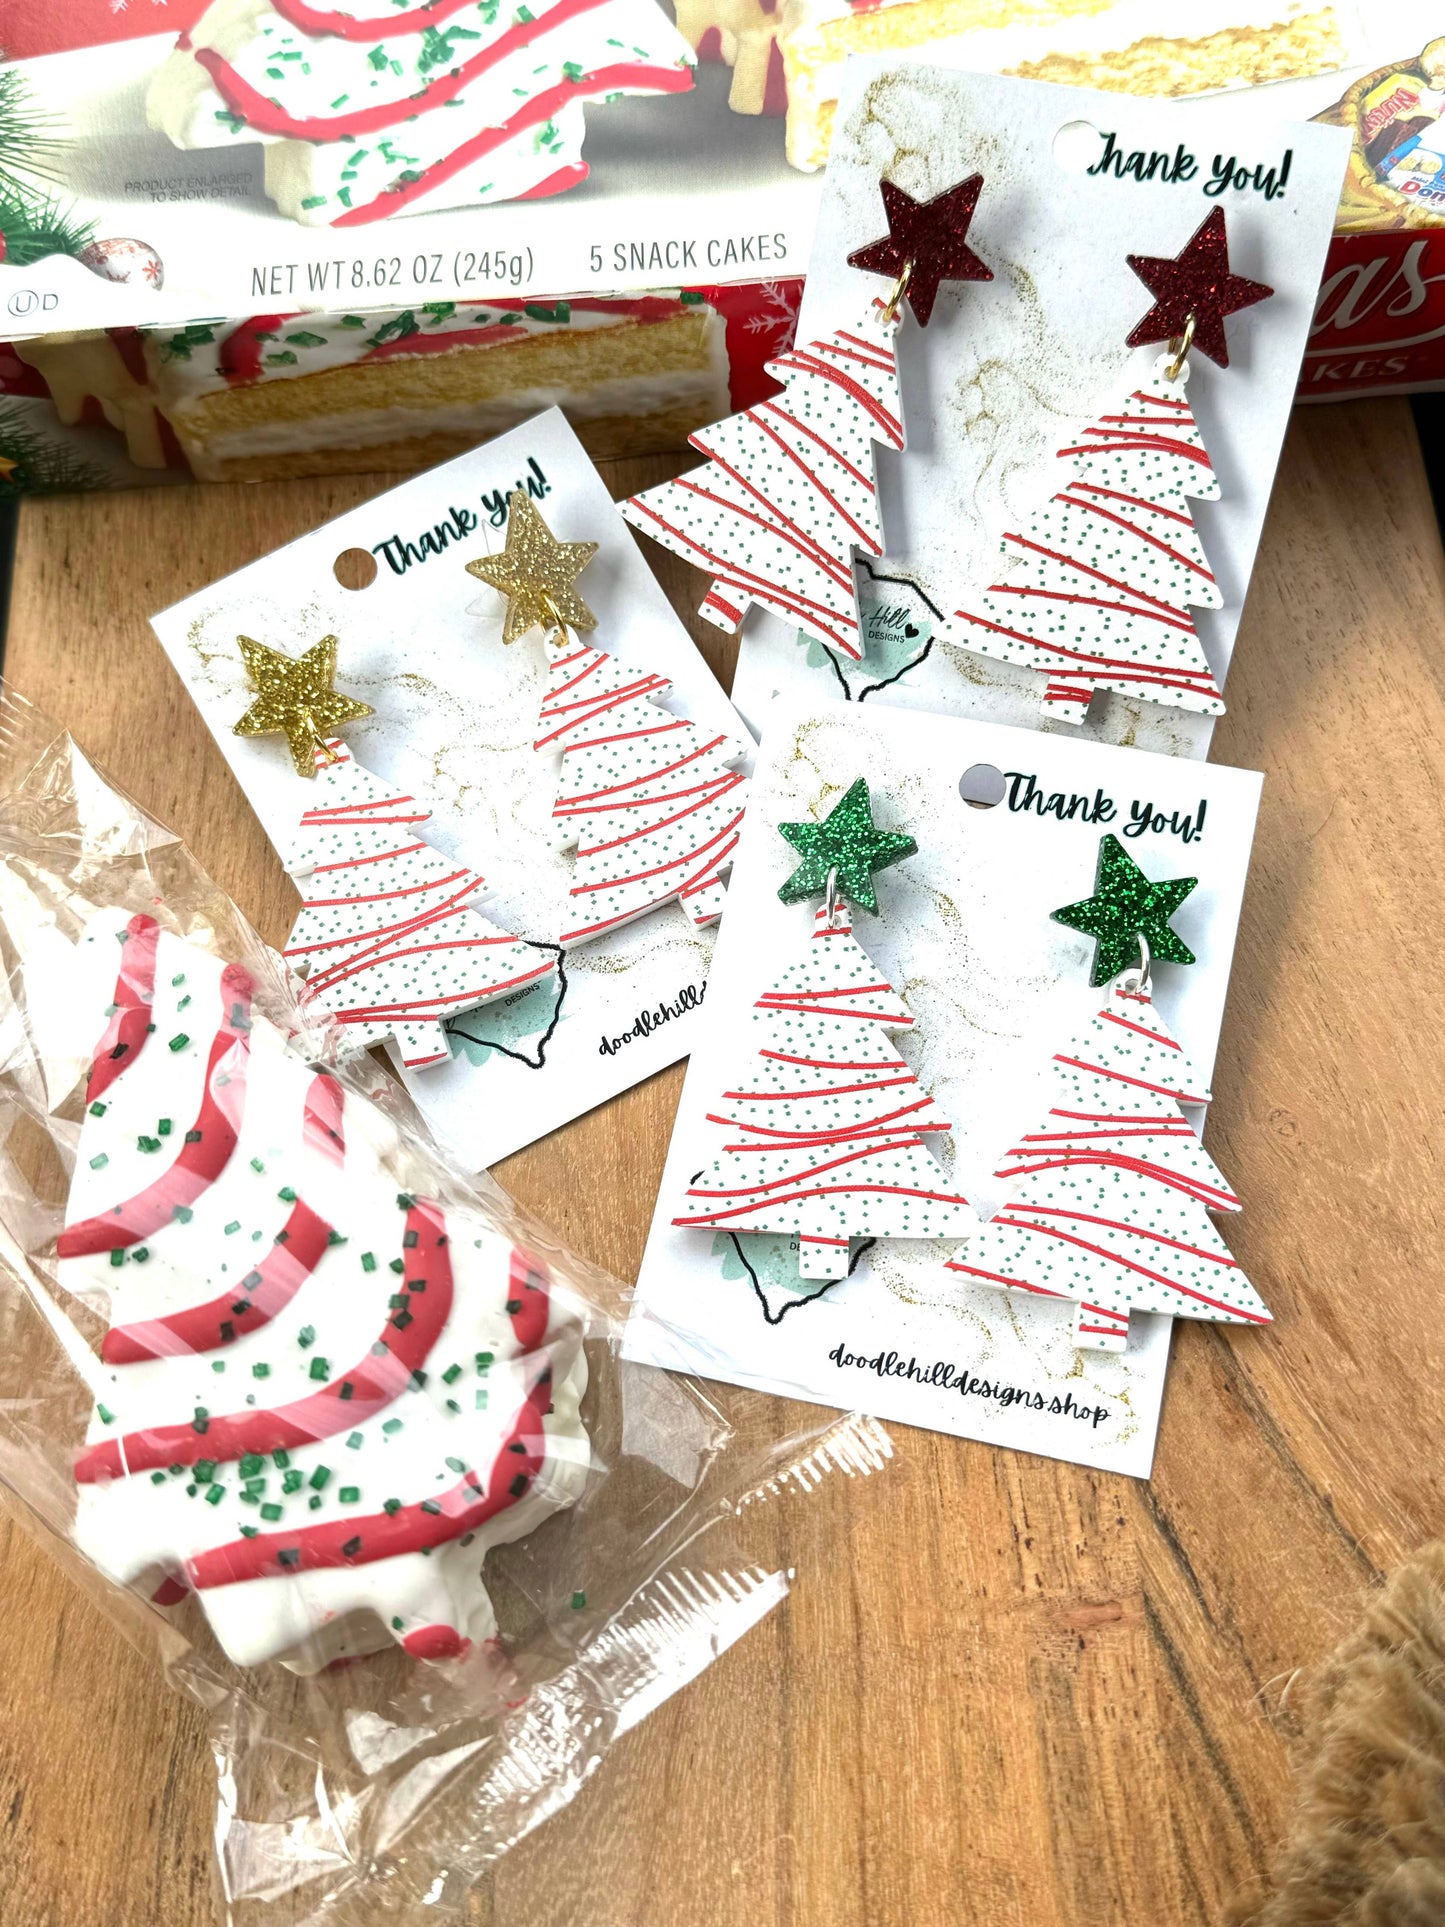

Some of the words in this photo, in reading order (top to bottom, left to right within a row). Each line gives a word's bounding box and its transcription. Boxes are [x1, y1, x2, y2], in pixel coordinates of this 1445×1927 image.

[124, 178, 184, 193] PRODUCT
[187, 172, 253, 188] ENLARGED
[1203, 149, 1293, 201] you!
[150, 192, 166, 203] TO
[169, 188, 207, 201] SHOW
[210, 186, 250, 198] DETAIL
[590, 244, 603, 273] 5
[613, 240, 698, 271] SNACK
[707, 233, 788, 267] CAKES
[251, 264, 298, 297] NET
[308, 261, 344, 292] WT
[351, 257, 401, 288] 8.62
[413, 253, 445, 285] OZ
[453, 247, 534, 287] (245g)
[1301, 356, 1410, 383] KES
[371, 506, 478, 576] Thank
[868, 605, 911, 630] Hill
[868, 630, 906, 644] DESIGNS
[1003, 771, 1118, 825] Thank
[1122, 799, 1207, 844] you!
[504, 982, 541, 1008] DESIGNS
